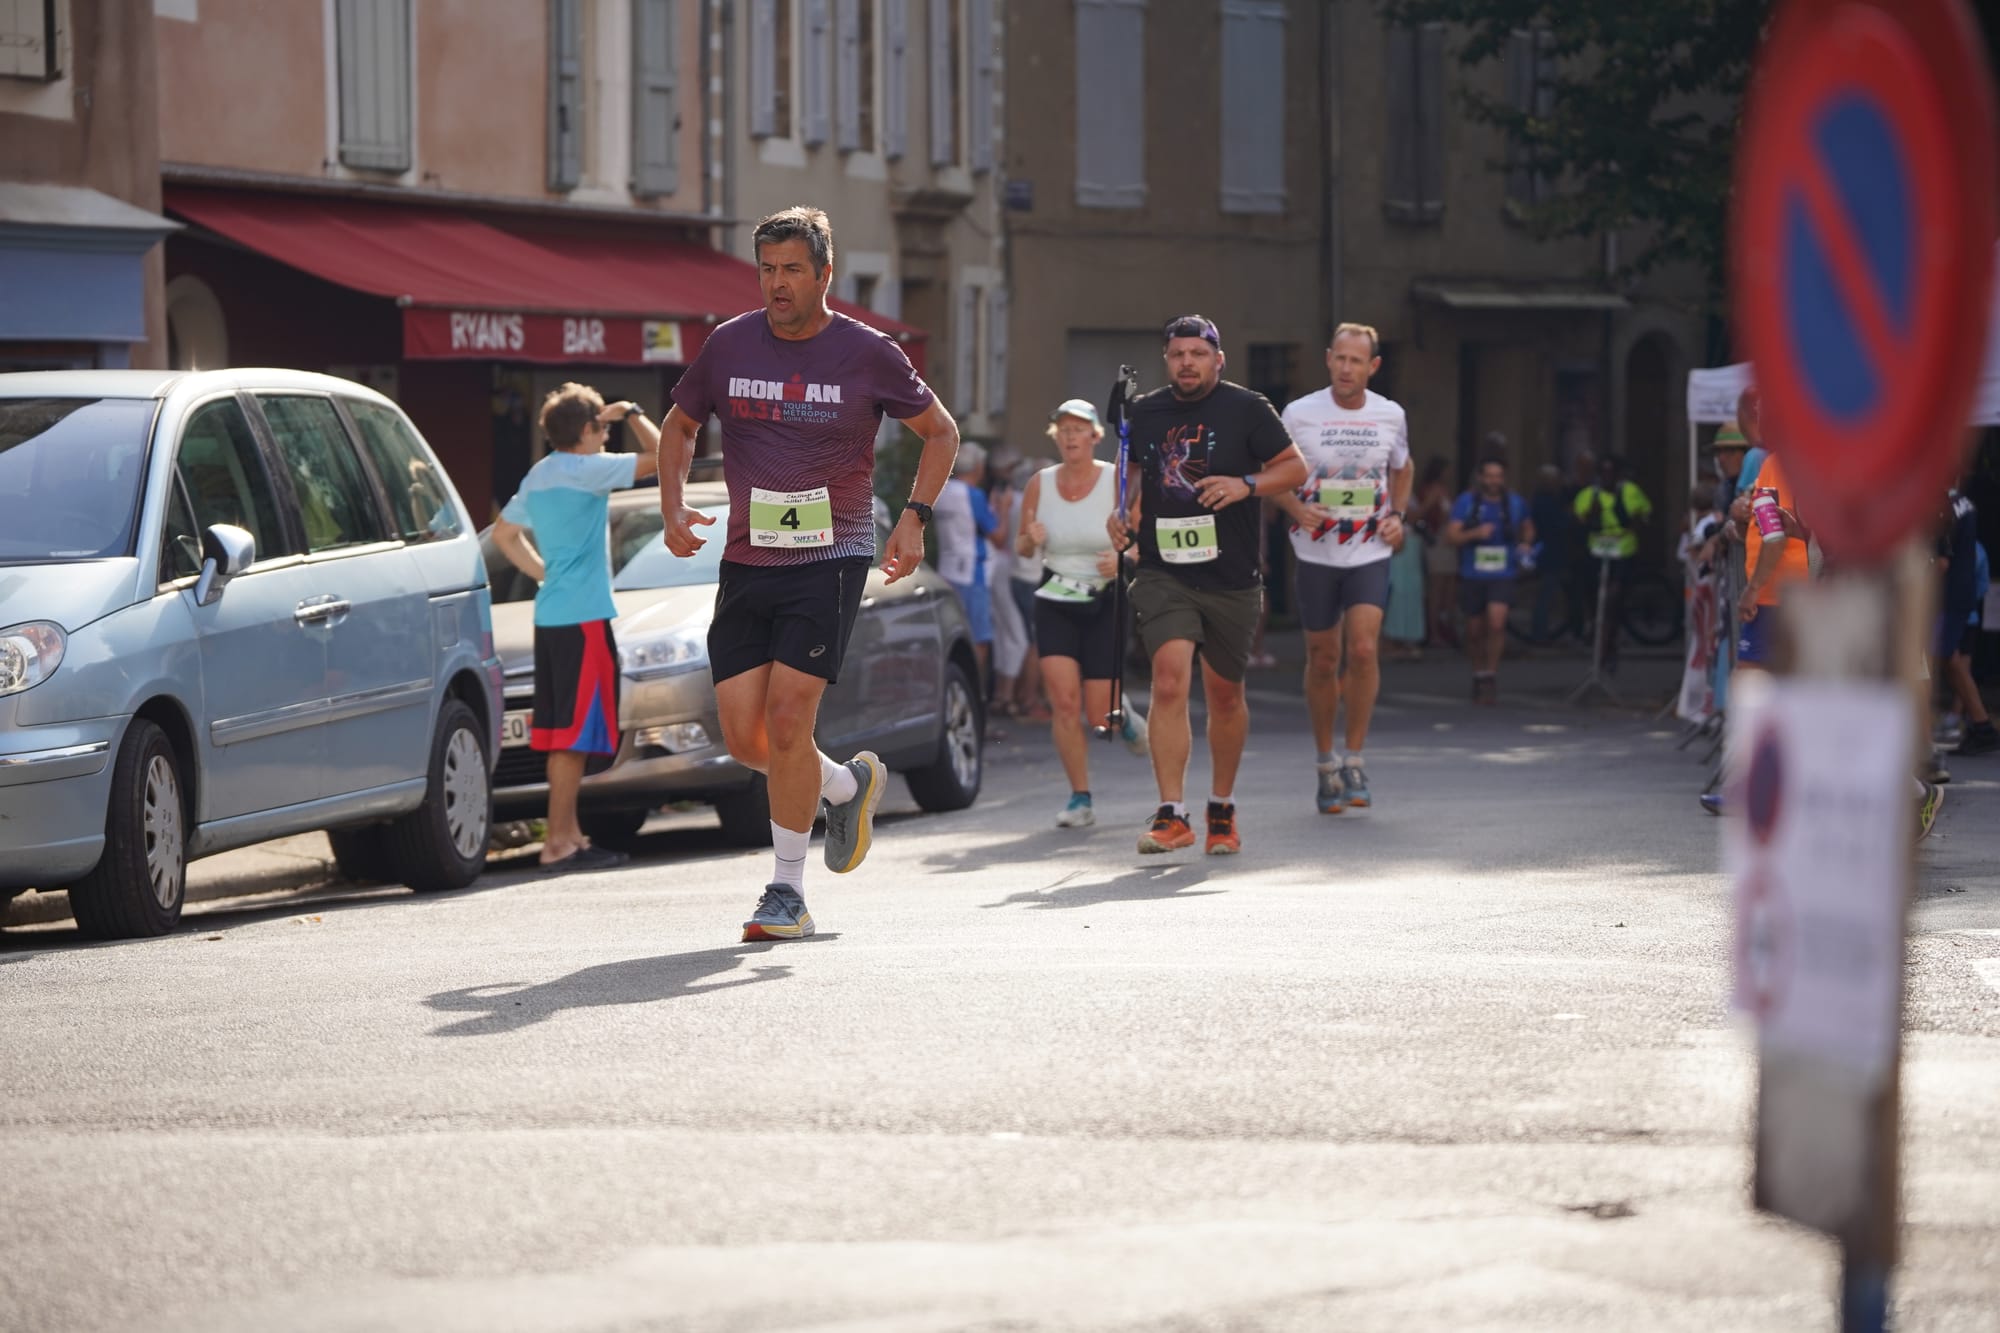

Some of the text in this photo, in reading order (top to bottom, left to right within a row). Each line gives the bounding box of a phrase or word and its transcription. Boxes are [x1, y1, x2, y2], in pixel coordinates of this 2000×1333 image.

[450, 312, 525, 351] RYAN'S
[563, 319, 606, 354] BAR
[784, 402, 813, 410] TOURS
[1341, 490, 1354, 506] 2
[780, 507, 800, 529] 4
[1171, 529, 1199, 548] 10
